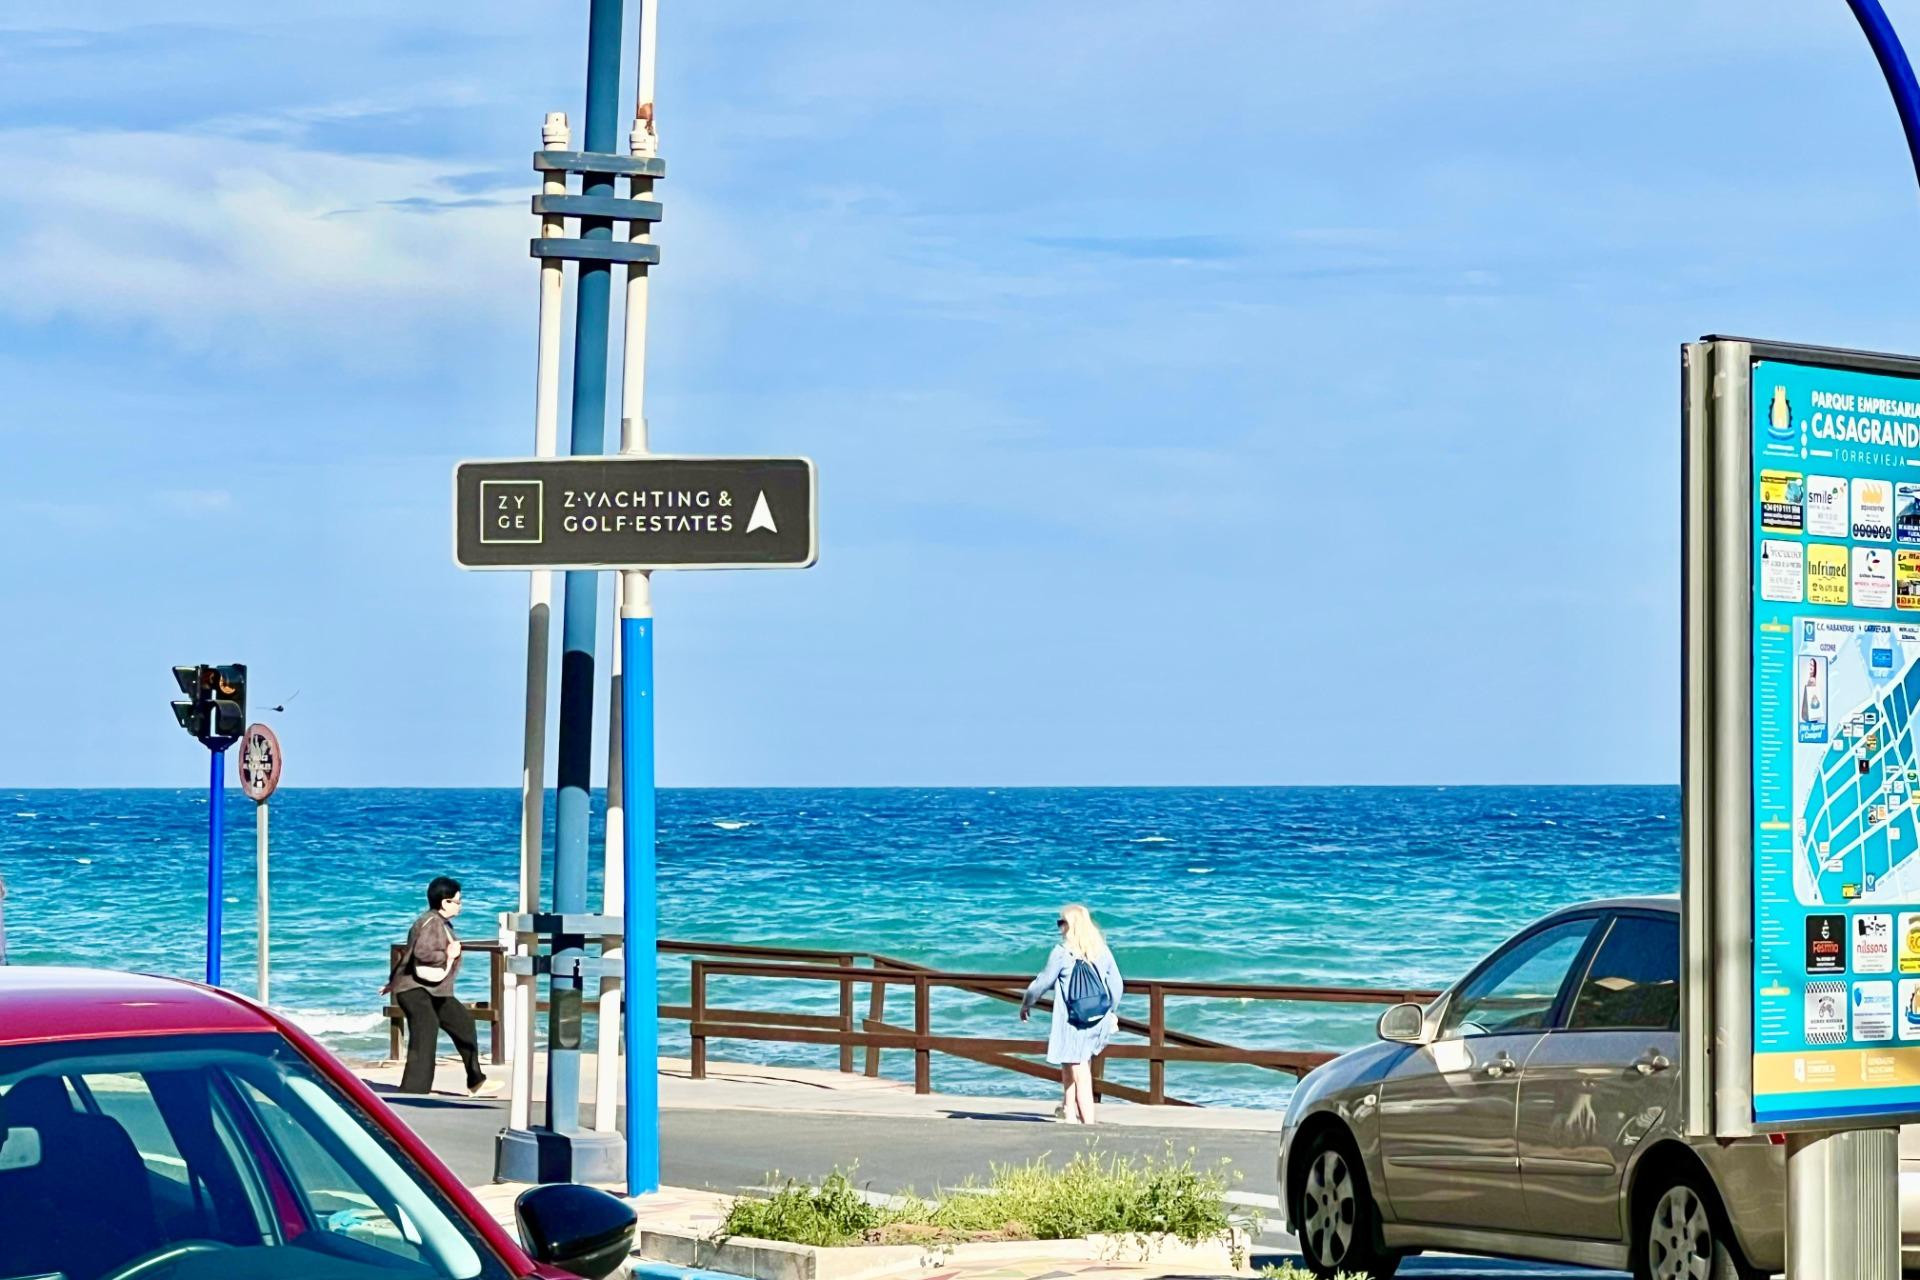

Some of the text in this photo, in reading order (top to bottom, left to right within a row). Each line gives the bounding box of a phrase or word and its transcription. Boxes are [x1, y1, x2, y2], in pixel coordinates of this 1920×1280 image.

[1811, 390, 1855, 412] PARQUE
[1811, 412, 1920, 449] CASAGRAND
[1835, 448, 1905, 467] TORREVIEJA
[718, 490, 733, 507] &
[1808, 491, 1833, 504] smile
[1808, 561, 1847, 577] Infrimed
[1857, 940, 1888, 953] nilssons
